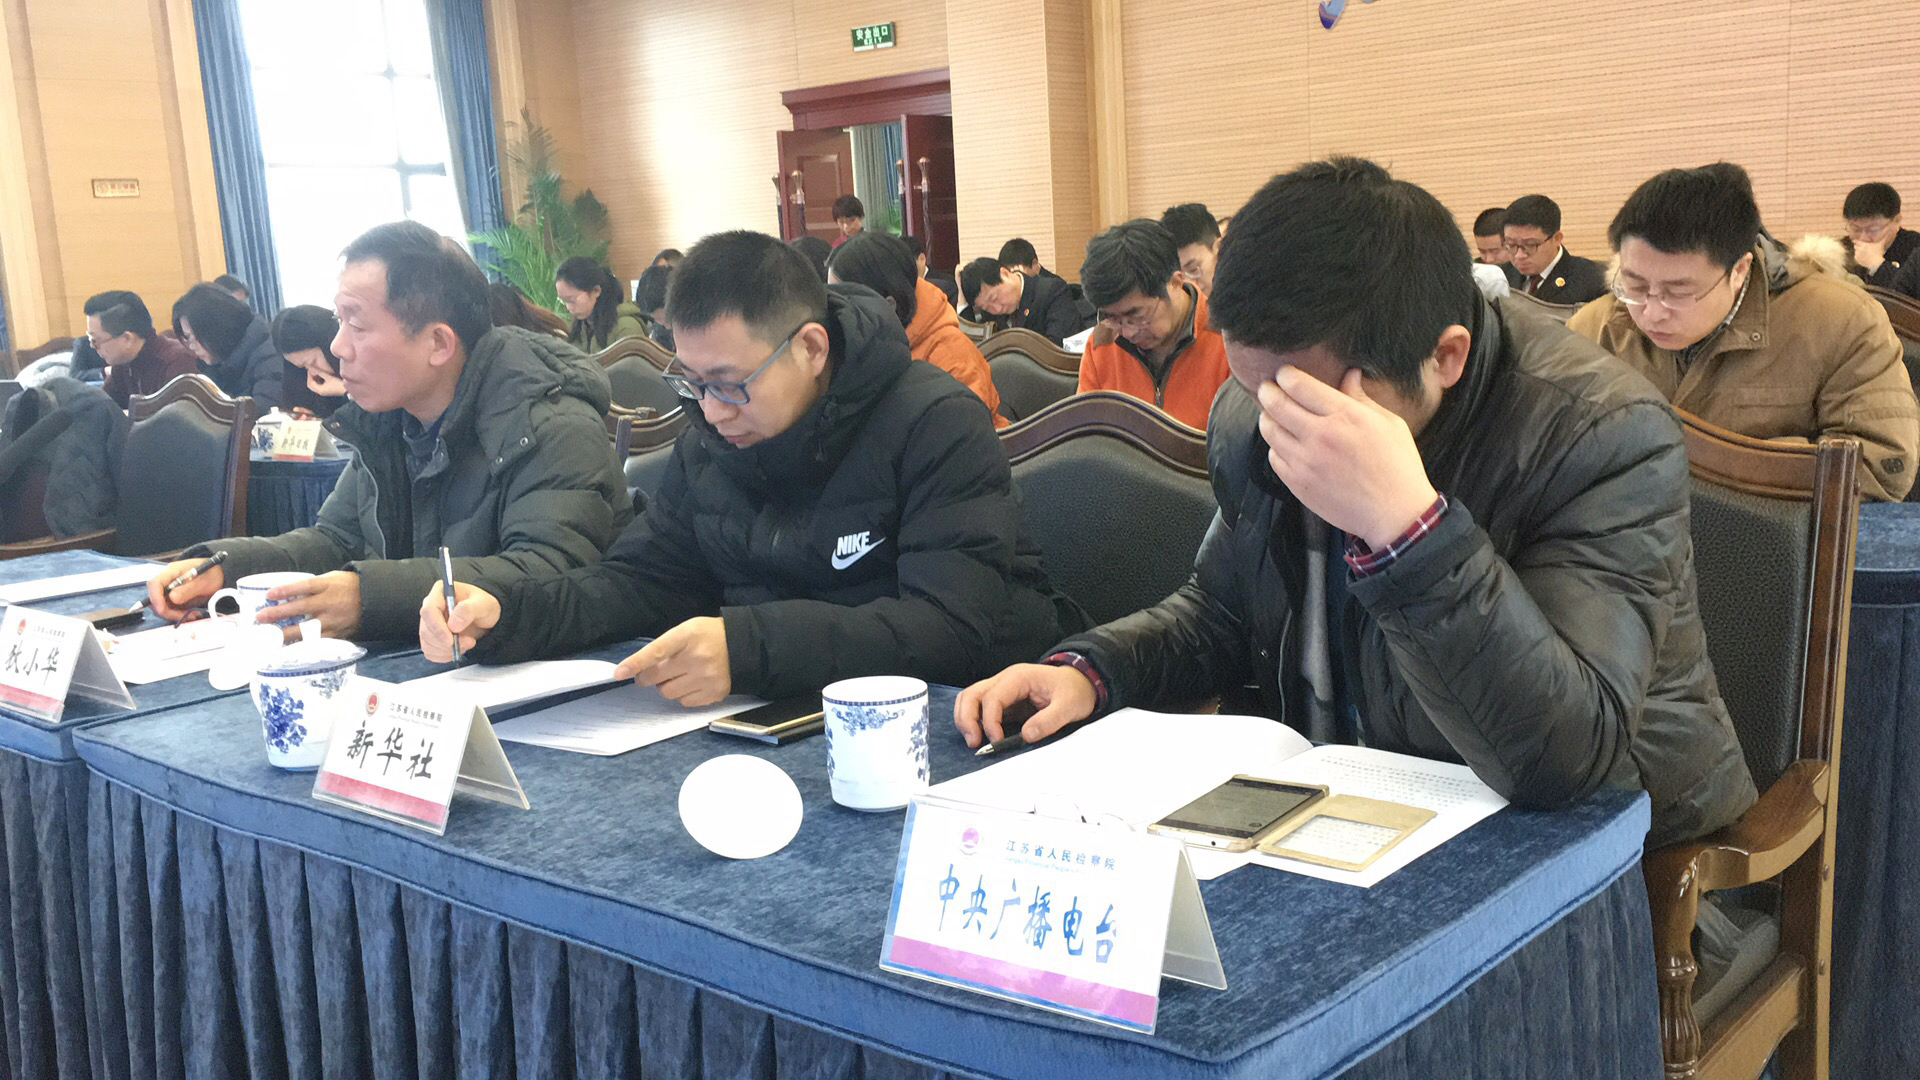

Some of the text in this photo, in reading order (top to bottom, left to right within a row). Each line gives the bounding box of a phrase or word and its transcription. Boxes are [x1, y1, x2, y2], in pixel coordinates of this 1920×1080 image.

[856, 26, 888, 40] 安全出口
[837, 531, 870, 556] NIKE
[347, 720, 434, 780] 新华社
[1006, 840, 1115, 870] 江苏省人民检察院
[939, 863, 1117, 964] 中央广播电台
